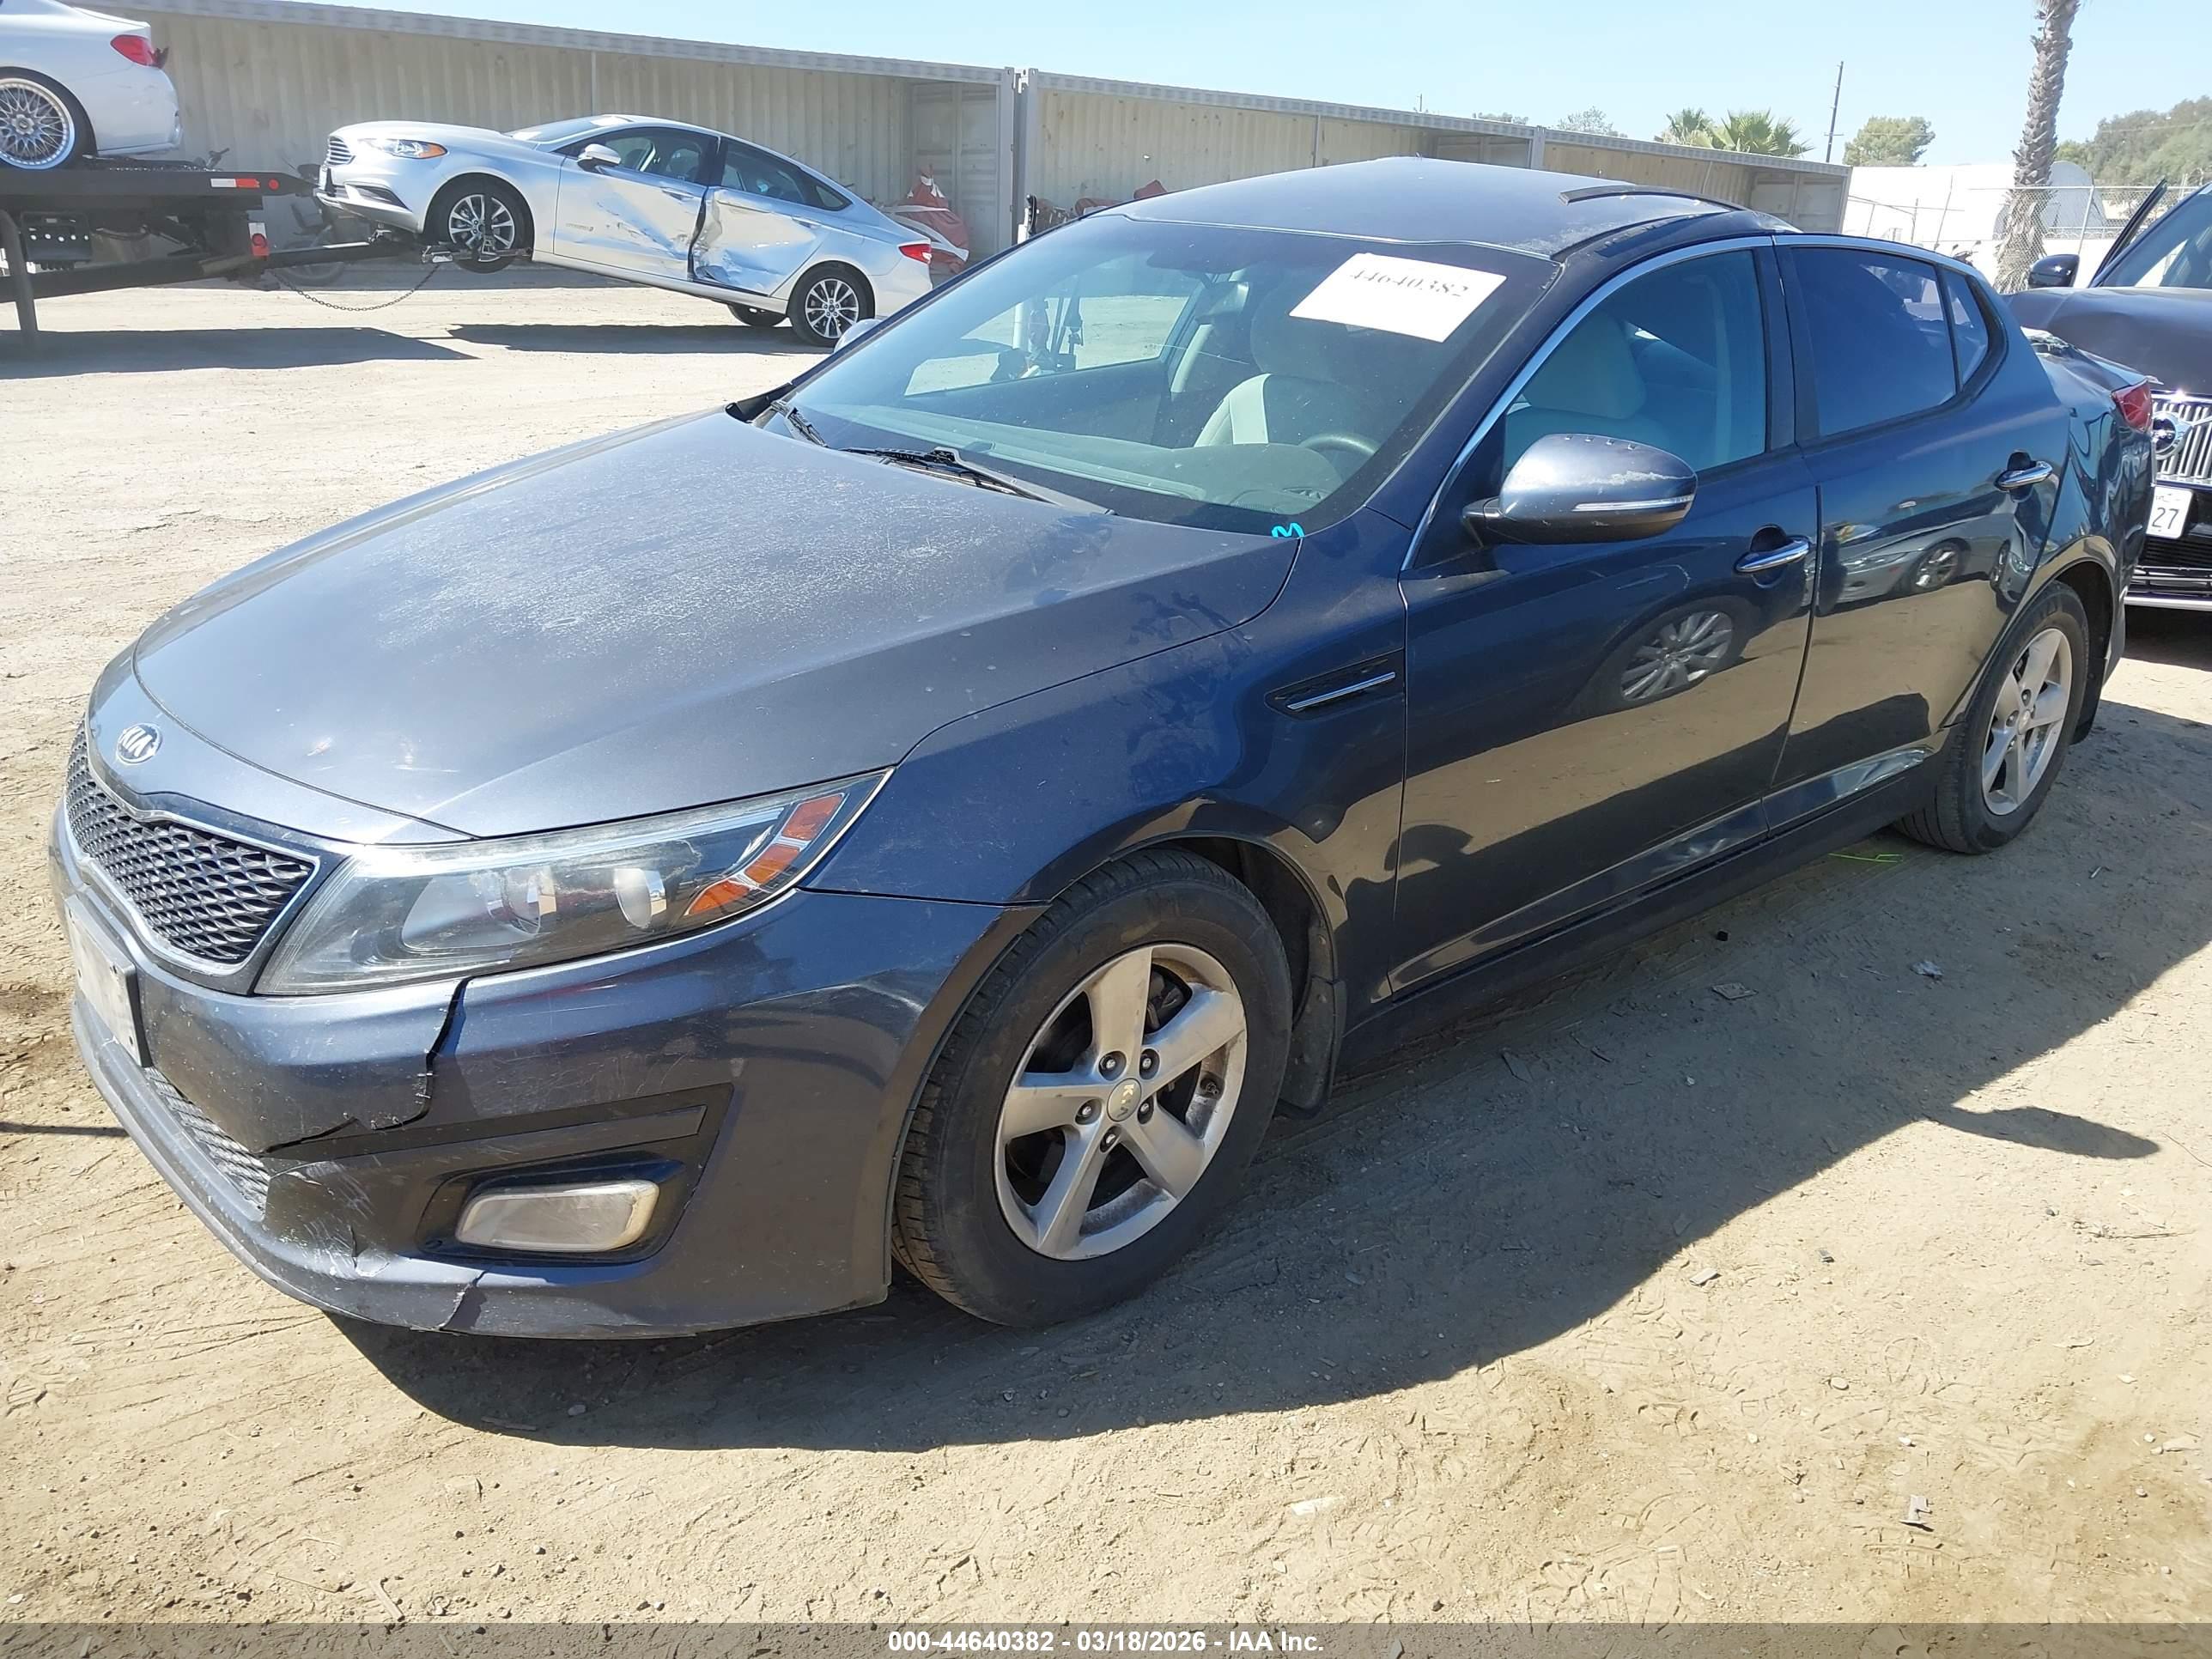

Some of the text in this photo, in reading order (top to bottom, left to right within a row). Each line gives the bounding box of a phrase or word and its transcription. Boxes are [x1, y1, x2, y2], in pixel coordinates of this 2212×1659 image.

[1349, 269, 1469, 297] 44640382
[118, 726, 153, 757] KIA
[1116, 1084, 1134, 1118] KIA
